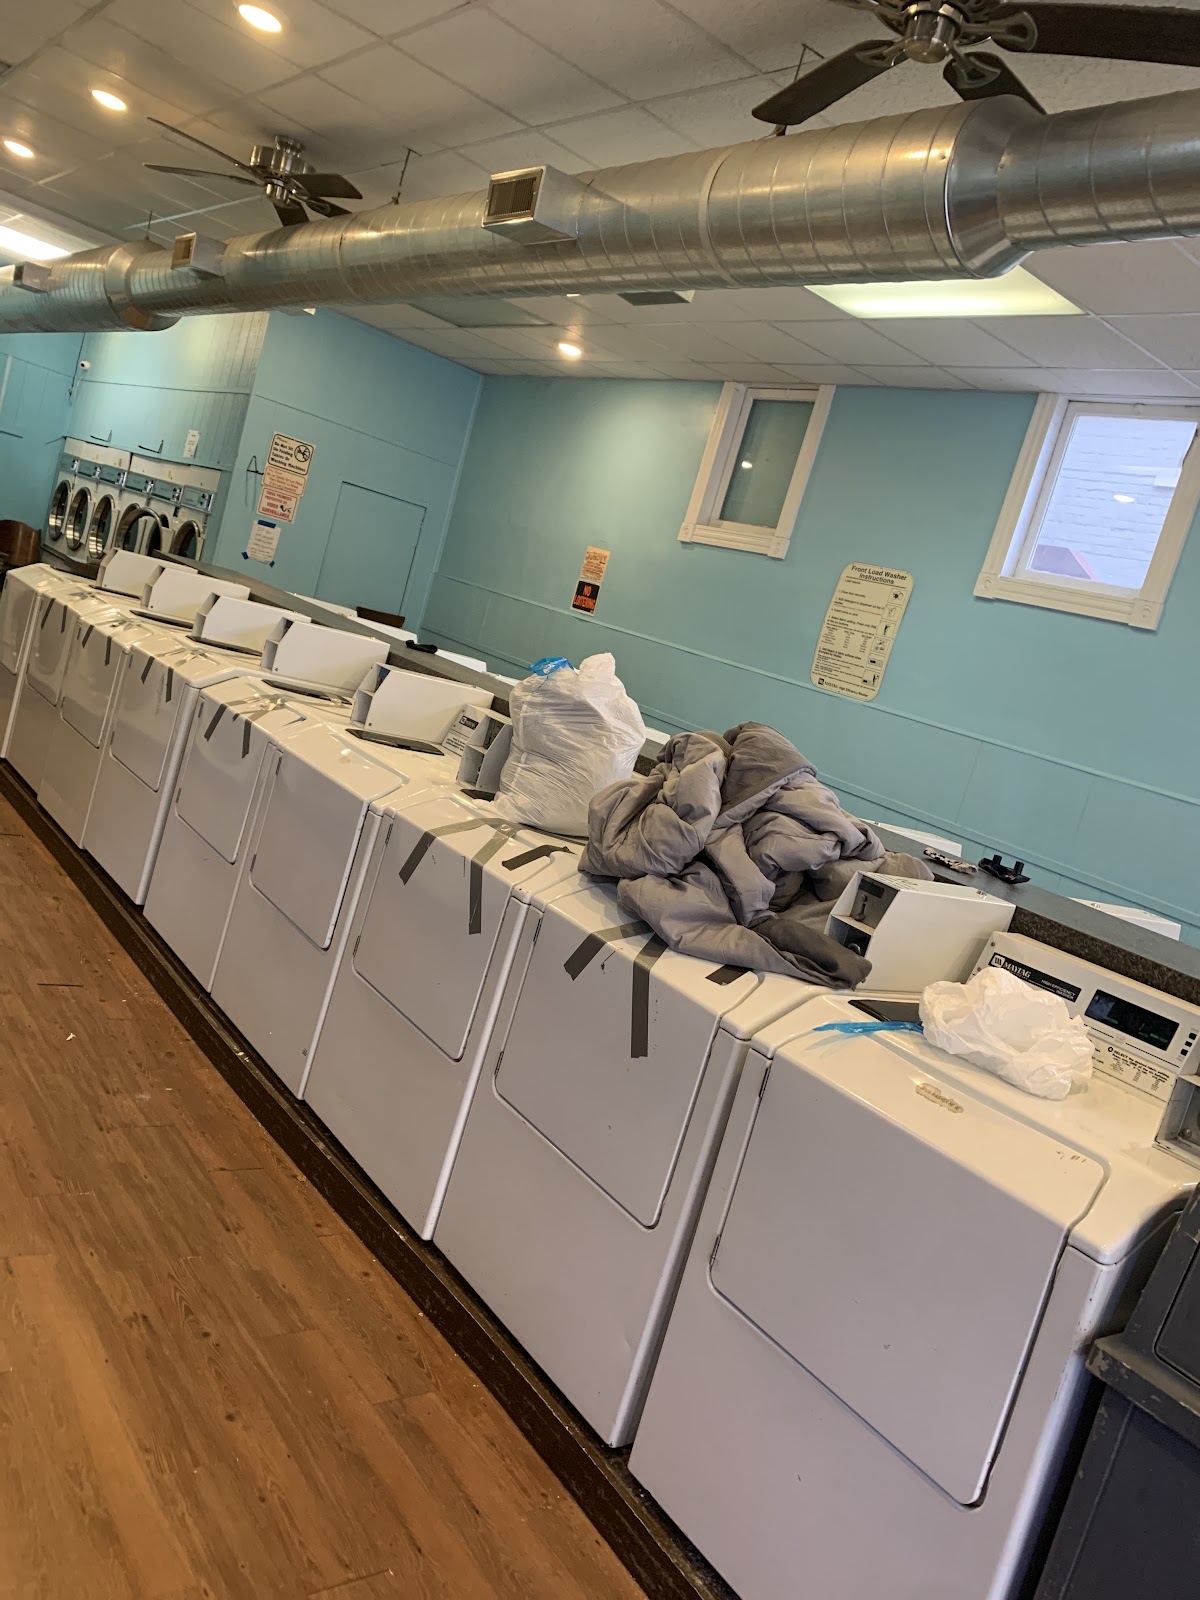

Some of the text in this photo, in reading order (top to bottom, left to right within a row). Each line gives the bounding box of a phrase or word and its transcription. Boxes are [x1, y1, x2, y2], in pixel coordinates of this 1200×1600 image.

[279, 449, 293, 457] Folding
[270, 457, 306, 472] Washing Machines
[265, 495, 282, 503] PROTECTED
[262, 507, 290, 519] SURVEILLANCE
[851, 565, 867, 574] Front
[884, 571, 908, 581] Washer
[858, 573, 895, 585] Instructions
[583, 585, 592, 596] NO
[573, 595, 596, 609] LOITERING
[1002, 961, 1032, 979] MAYTAG
[1040, 979, 1076, 997] HIGH EFFICIENCY
[1114, 1049, 1129, 1060] SELECT
